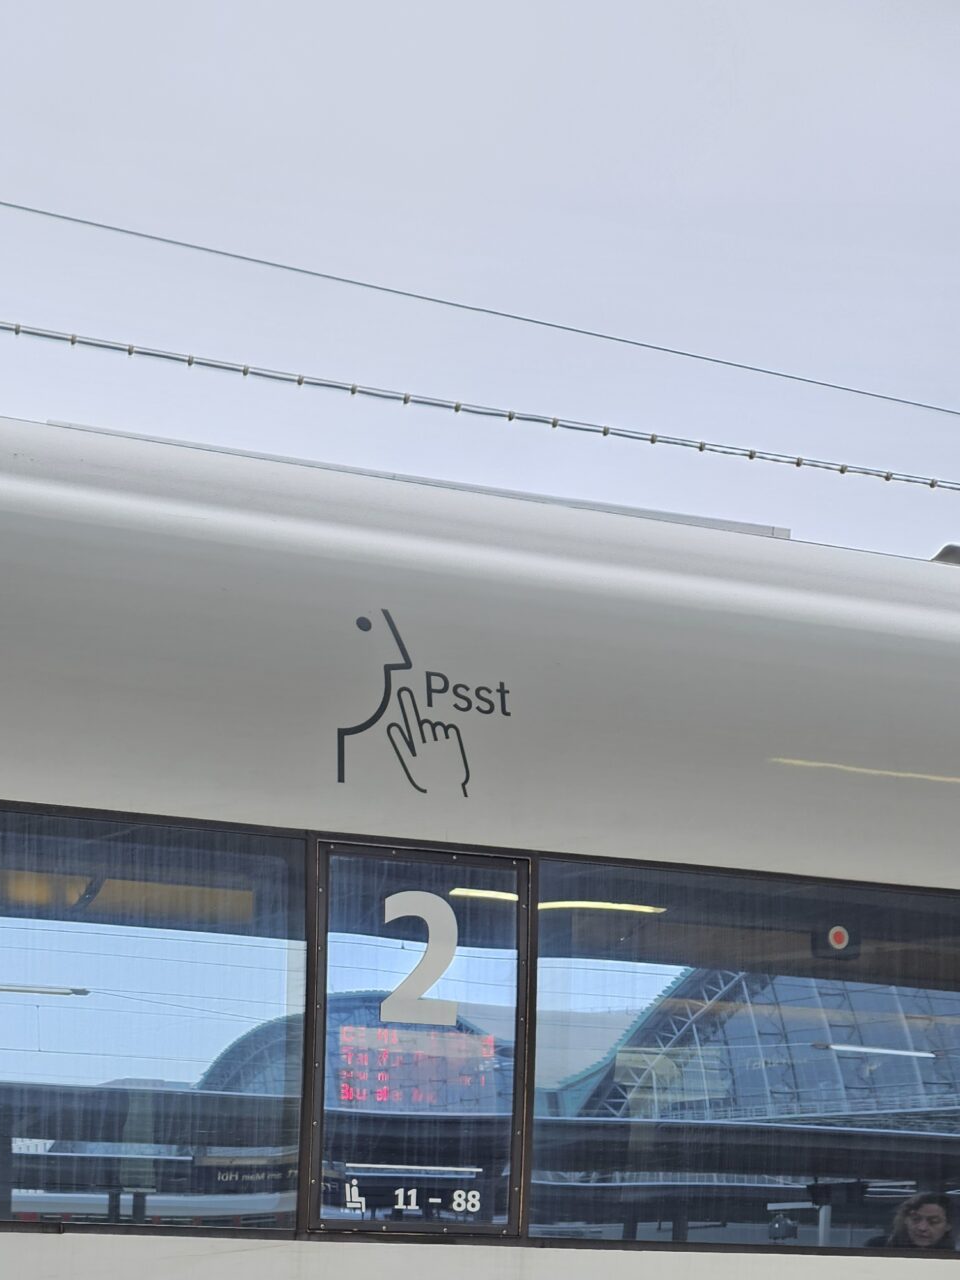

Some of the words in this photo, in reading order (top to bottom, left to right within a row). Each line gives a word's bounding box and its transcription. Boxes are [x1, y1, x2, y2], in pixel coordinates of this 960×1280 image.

[425, 670, 511, 717] Psst
[380, 890, 458, 1026] 2
[394, 1187, 419, 1209] 11
[452, 1189, 481, 1212] 88
